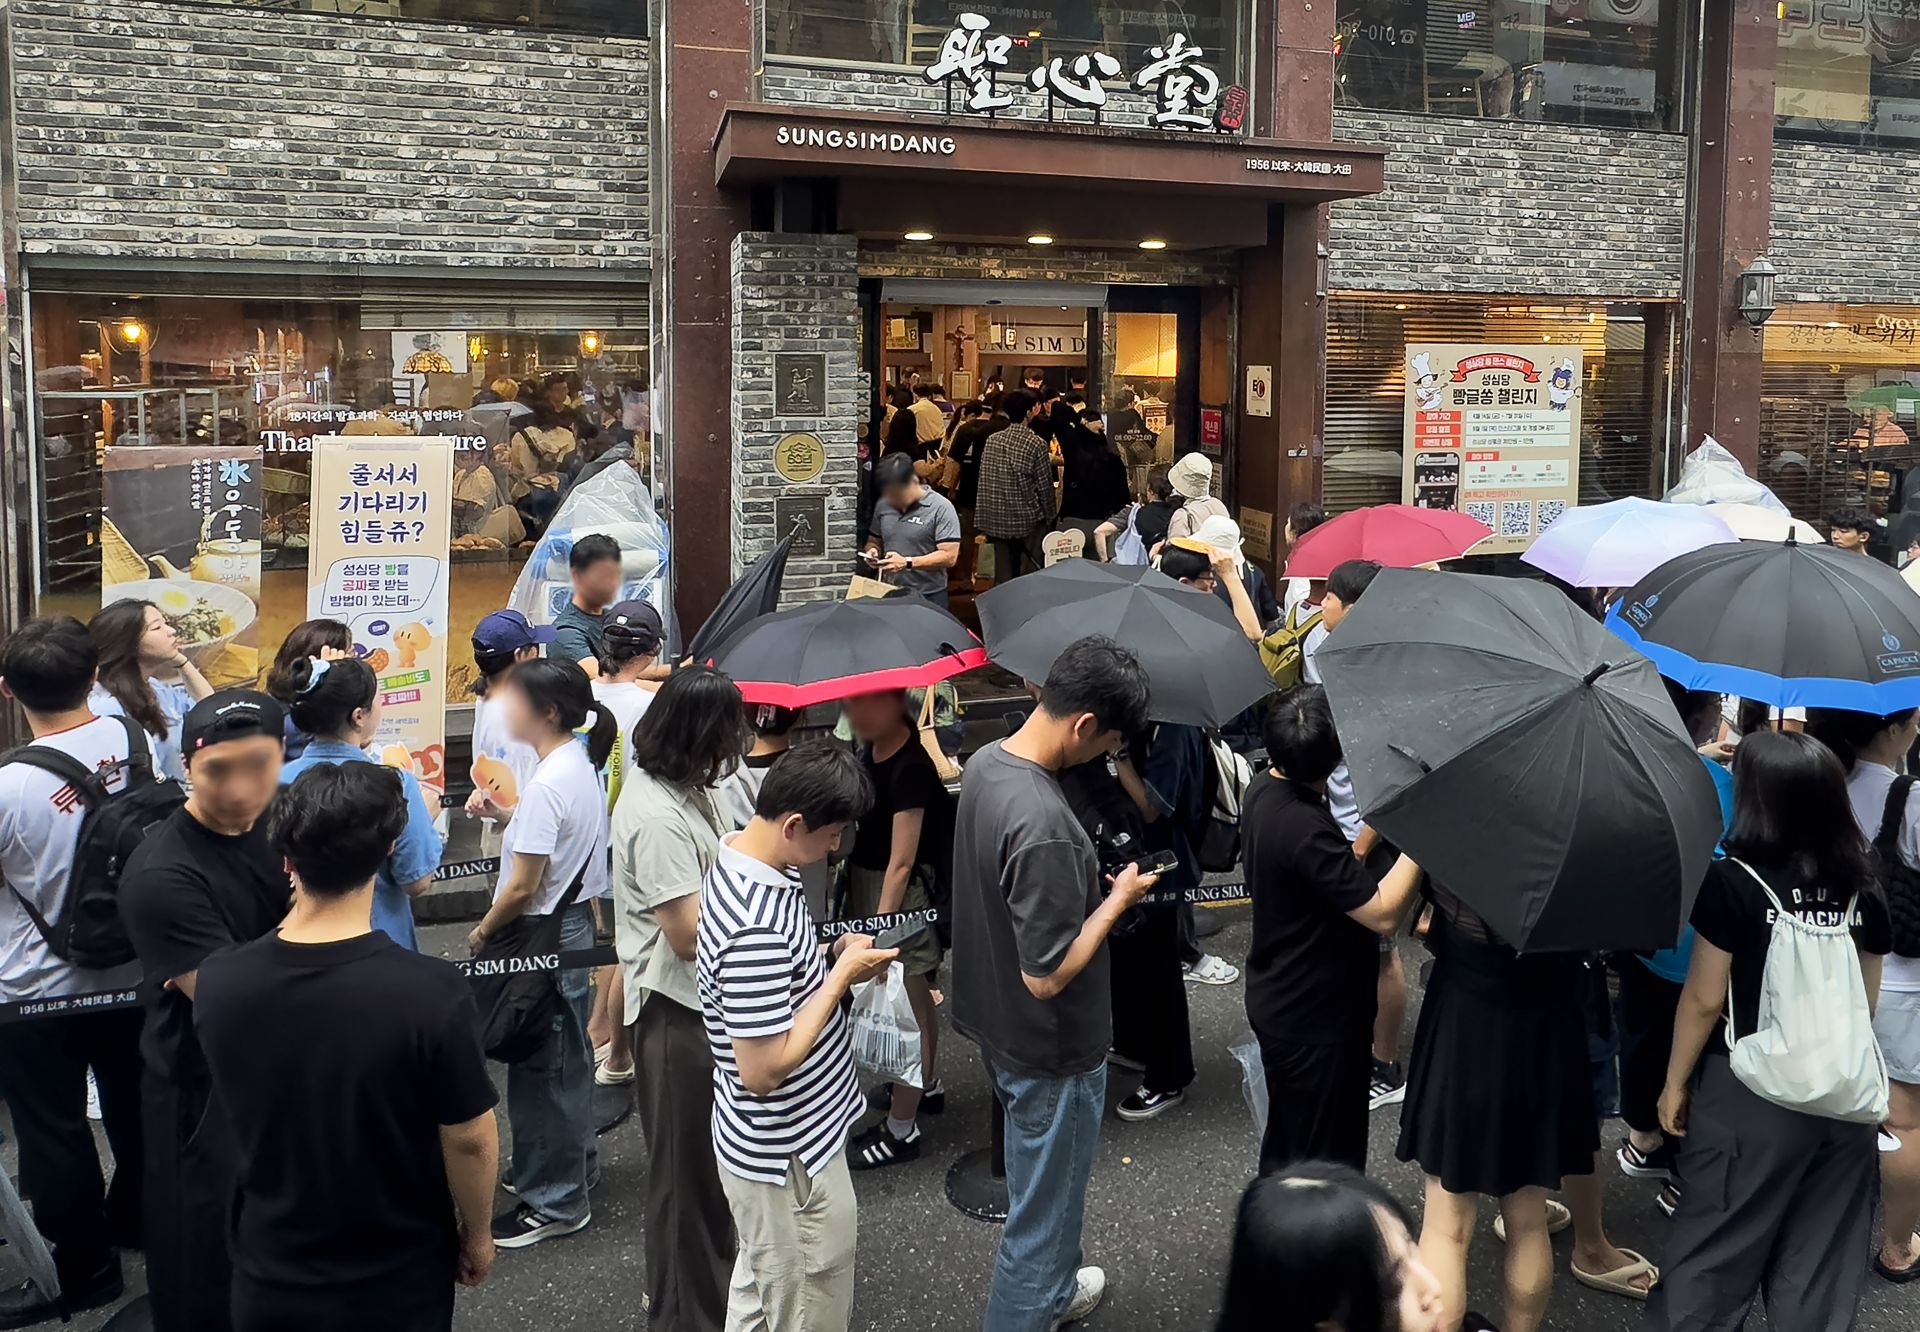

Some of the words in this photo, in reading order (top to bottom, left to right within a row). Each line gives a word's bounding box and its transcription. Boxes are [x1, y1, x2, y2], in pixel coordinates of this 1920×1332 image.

[923, 12, 1220, 126] 聖心堂
[776, 127, 956, 154] SUNGSIMDANG
[1246, 159, 1270, 170] 1956
[1025, 336, 1062, 353] SIM
[1482, 374, 1511, 386] 성심당
[1453, 388, 1494, 405] 빵글쏭
[1498, 388, 1537, 404] 챌린지
[260, 431, 314, 452] Tha
[348, 462, 418, 487] 줄서서
[339, 491, 427, 515] 기다리기
[340, 520, 425, 544] 힘들쥬?
[343, 563, 380, 577] 성심당
[343, 579, 380, 592] 공짜로
[384, 579, 409, 591] 받는
[329, 595, 367, 607] 방법이
[449, 860, 494, 878] DANG
[1184, 887, 1219, 902] SUNG
[1221, 884, 1244, 898] SIM
[822, 919, 863, 937] SUNG
[865, 915, 892, 931] SIM
[474, 958, 506, 976] SIM
[509, 953, 560, 973] DANG
[19, 1004, 45, 1015] 1956
